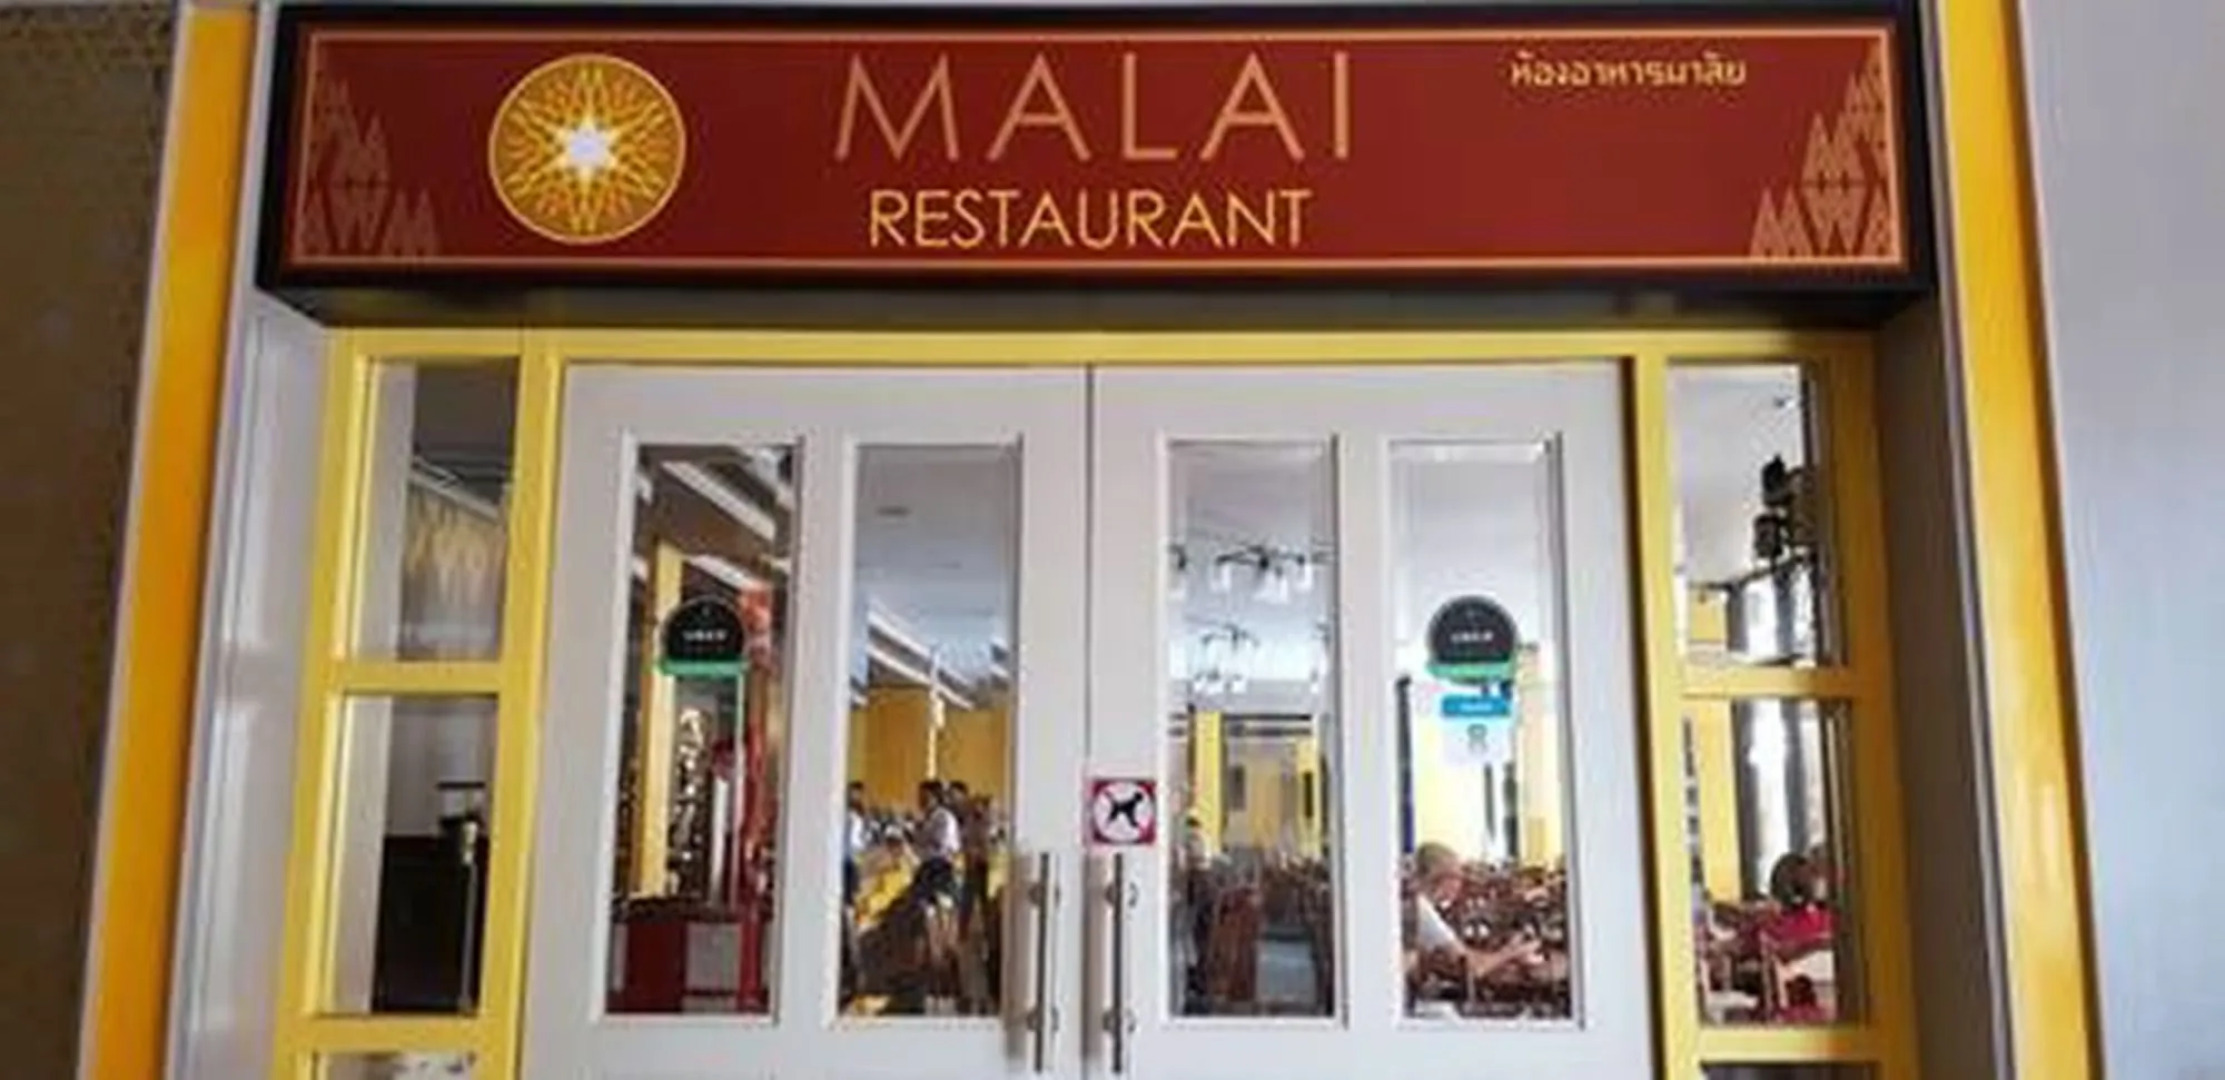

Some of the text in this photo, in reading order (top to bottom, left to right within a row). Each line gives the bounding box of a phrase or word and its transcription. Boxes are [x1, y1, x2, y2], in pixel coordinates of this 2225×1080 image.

[1510, 50, 1747, 86] ห้องอาหารมาลัย
[835, 52, 1349, 160] MALAI
[870, 190, 1312, 249] RESTAURANT
